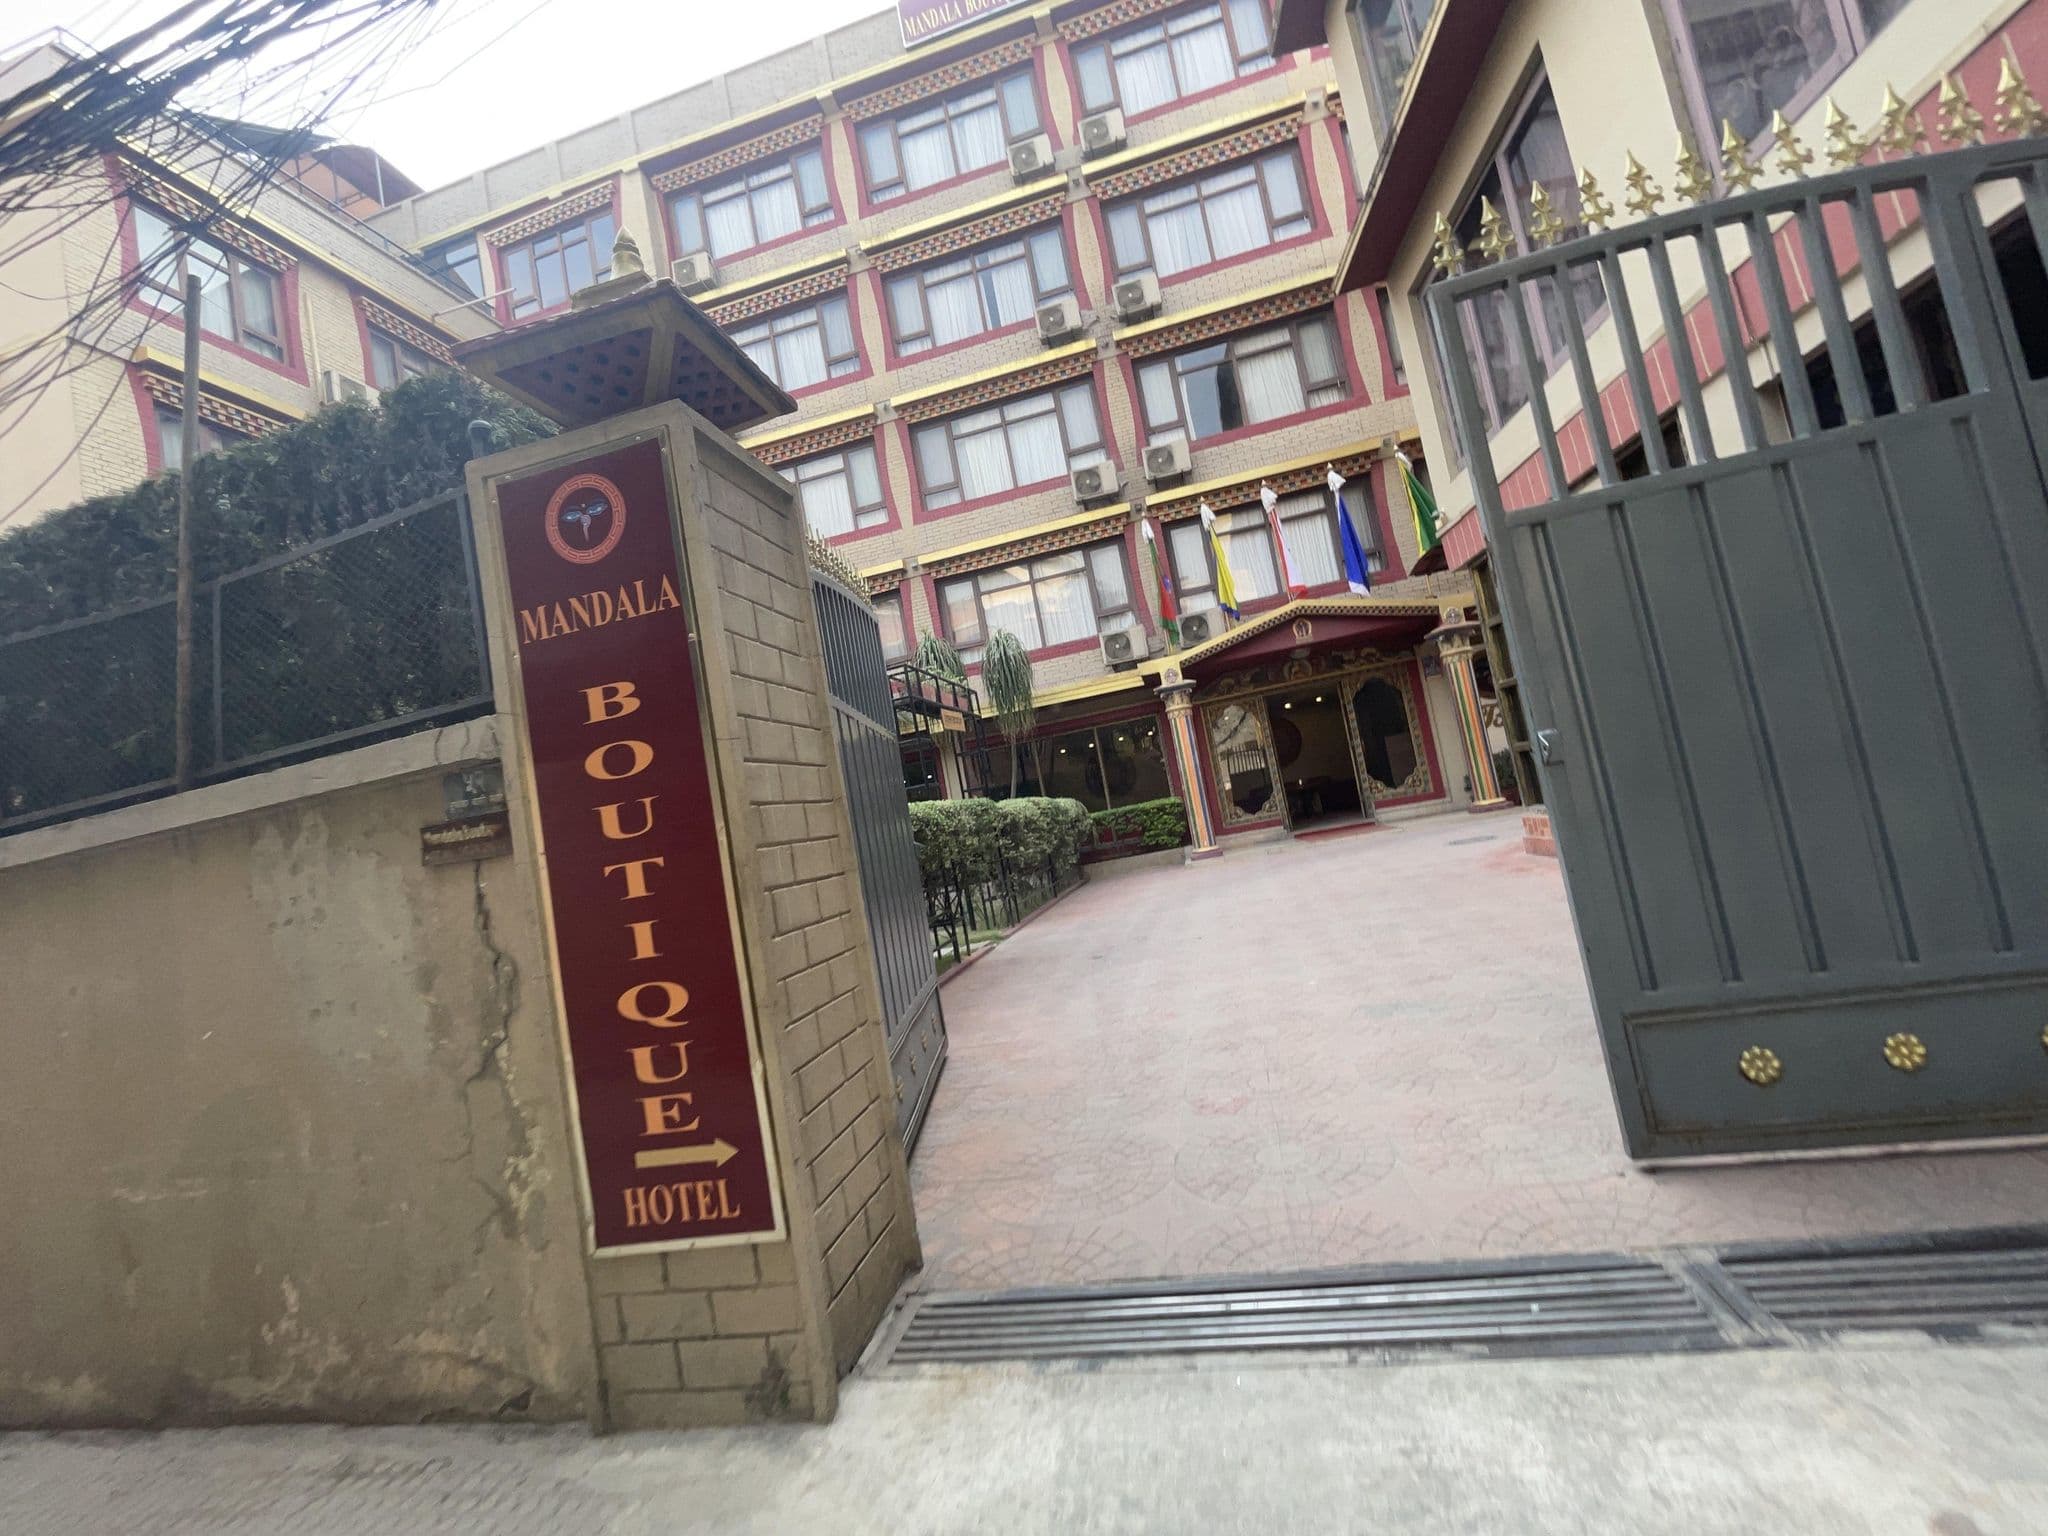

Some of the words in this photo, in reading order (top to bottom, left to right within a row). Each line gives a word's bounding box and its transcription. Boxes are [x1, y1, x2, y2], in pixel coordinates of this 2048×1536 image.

[904, 1, 962, 37] MANDALA
[520, 573, 681, 645] MANDALA
[577, 680, 700, 1137] BOUTIQUE
[622, 1178, 741, 1228] HOTEL
